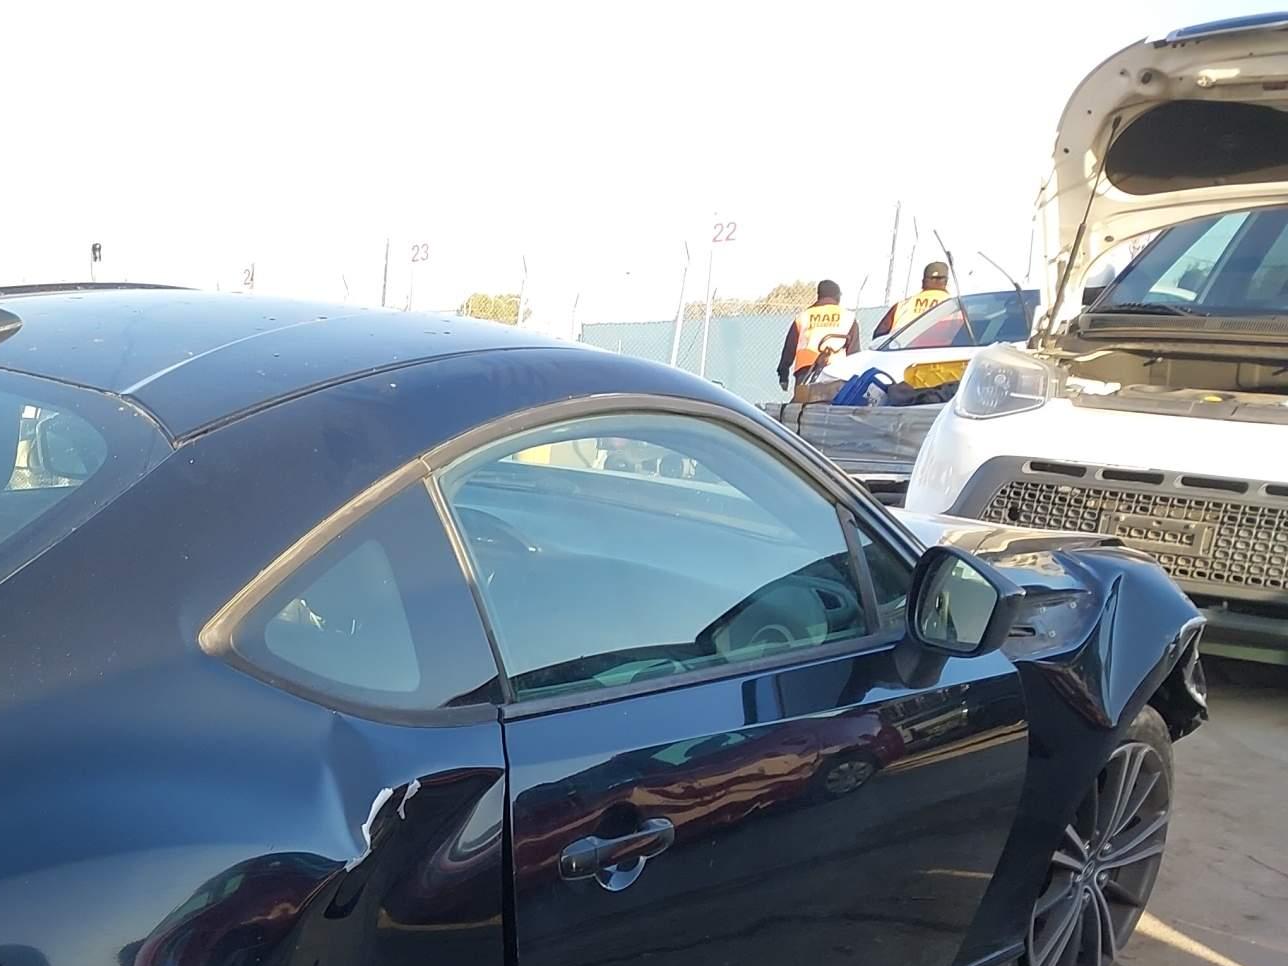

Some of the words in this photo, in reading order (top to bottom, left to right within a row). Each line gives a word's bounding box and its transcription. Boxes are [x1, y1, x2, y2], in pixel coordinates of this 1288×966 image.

[712, 222, 736, 242] 22
[412, 243, 429, 262] 23
[915, 298, 938, 308] MA
[810, 313, 840, 322] MAD
